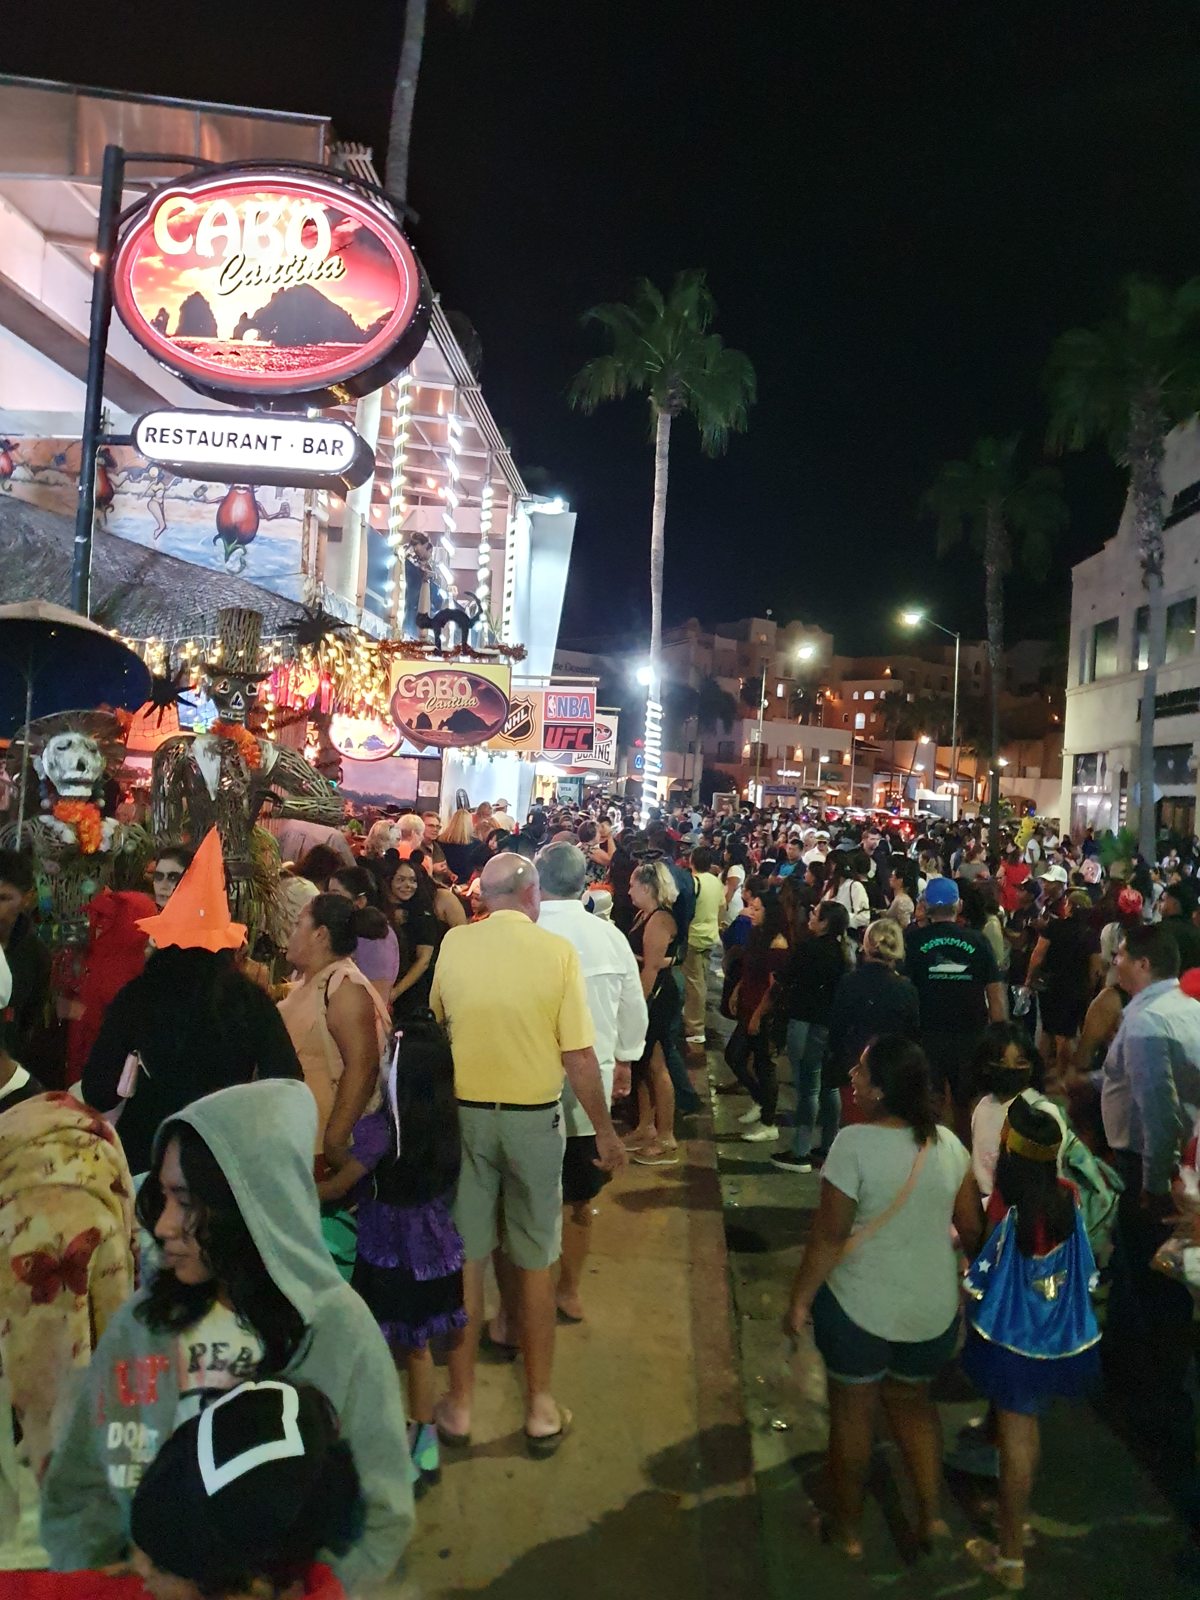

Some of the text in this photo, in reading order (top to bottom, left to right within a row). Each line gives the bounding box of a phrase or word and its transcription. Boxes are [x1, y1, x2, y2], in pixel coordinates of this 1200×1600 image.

[154, 194, 332, 259] CABO
[217, 254, 347, 296] Cantina
[145, 426, 344, 457] RESTAURANT BAR
[398, 675, 473, 701] CABO
[425, 696, 480, 713] Cantina
[556, 695, 592, 719] NBA
[504, 708, 528, 734] NHL
[545, 727, 592, 750] UFC
